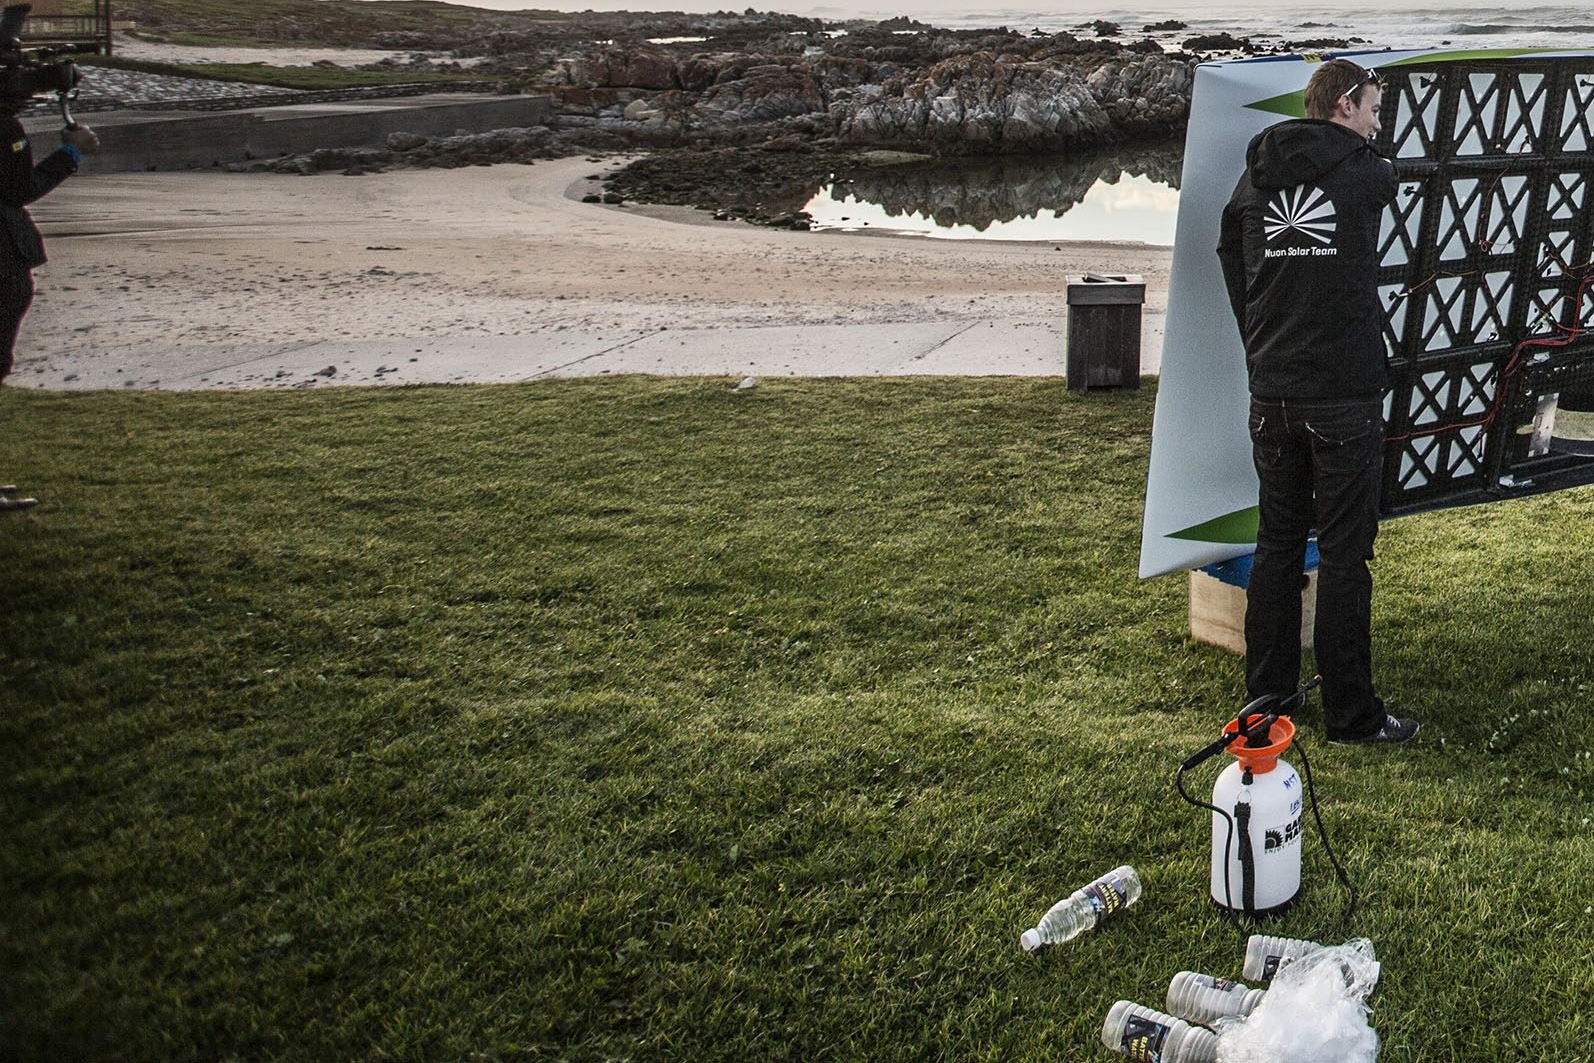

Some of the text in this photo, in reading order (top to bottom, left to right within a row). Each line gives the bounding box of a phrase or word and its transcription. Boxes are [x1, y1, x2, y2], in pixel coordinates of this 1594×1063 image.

[1265, 246, 1337, 258] Nuon Solar Team
